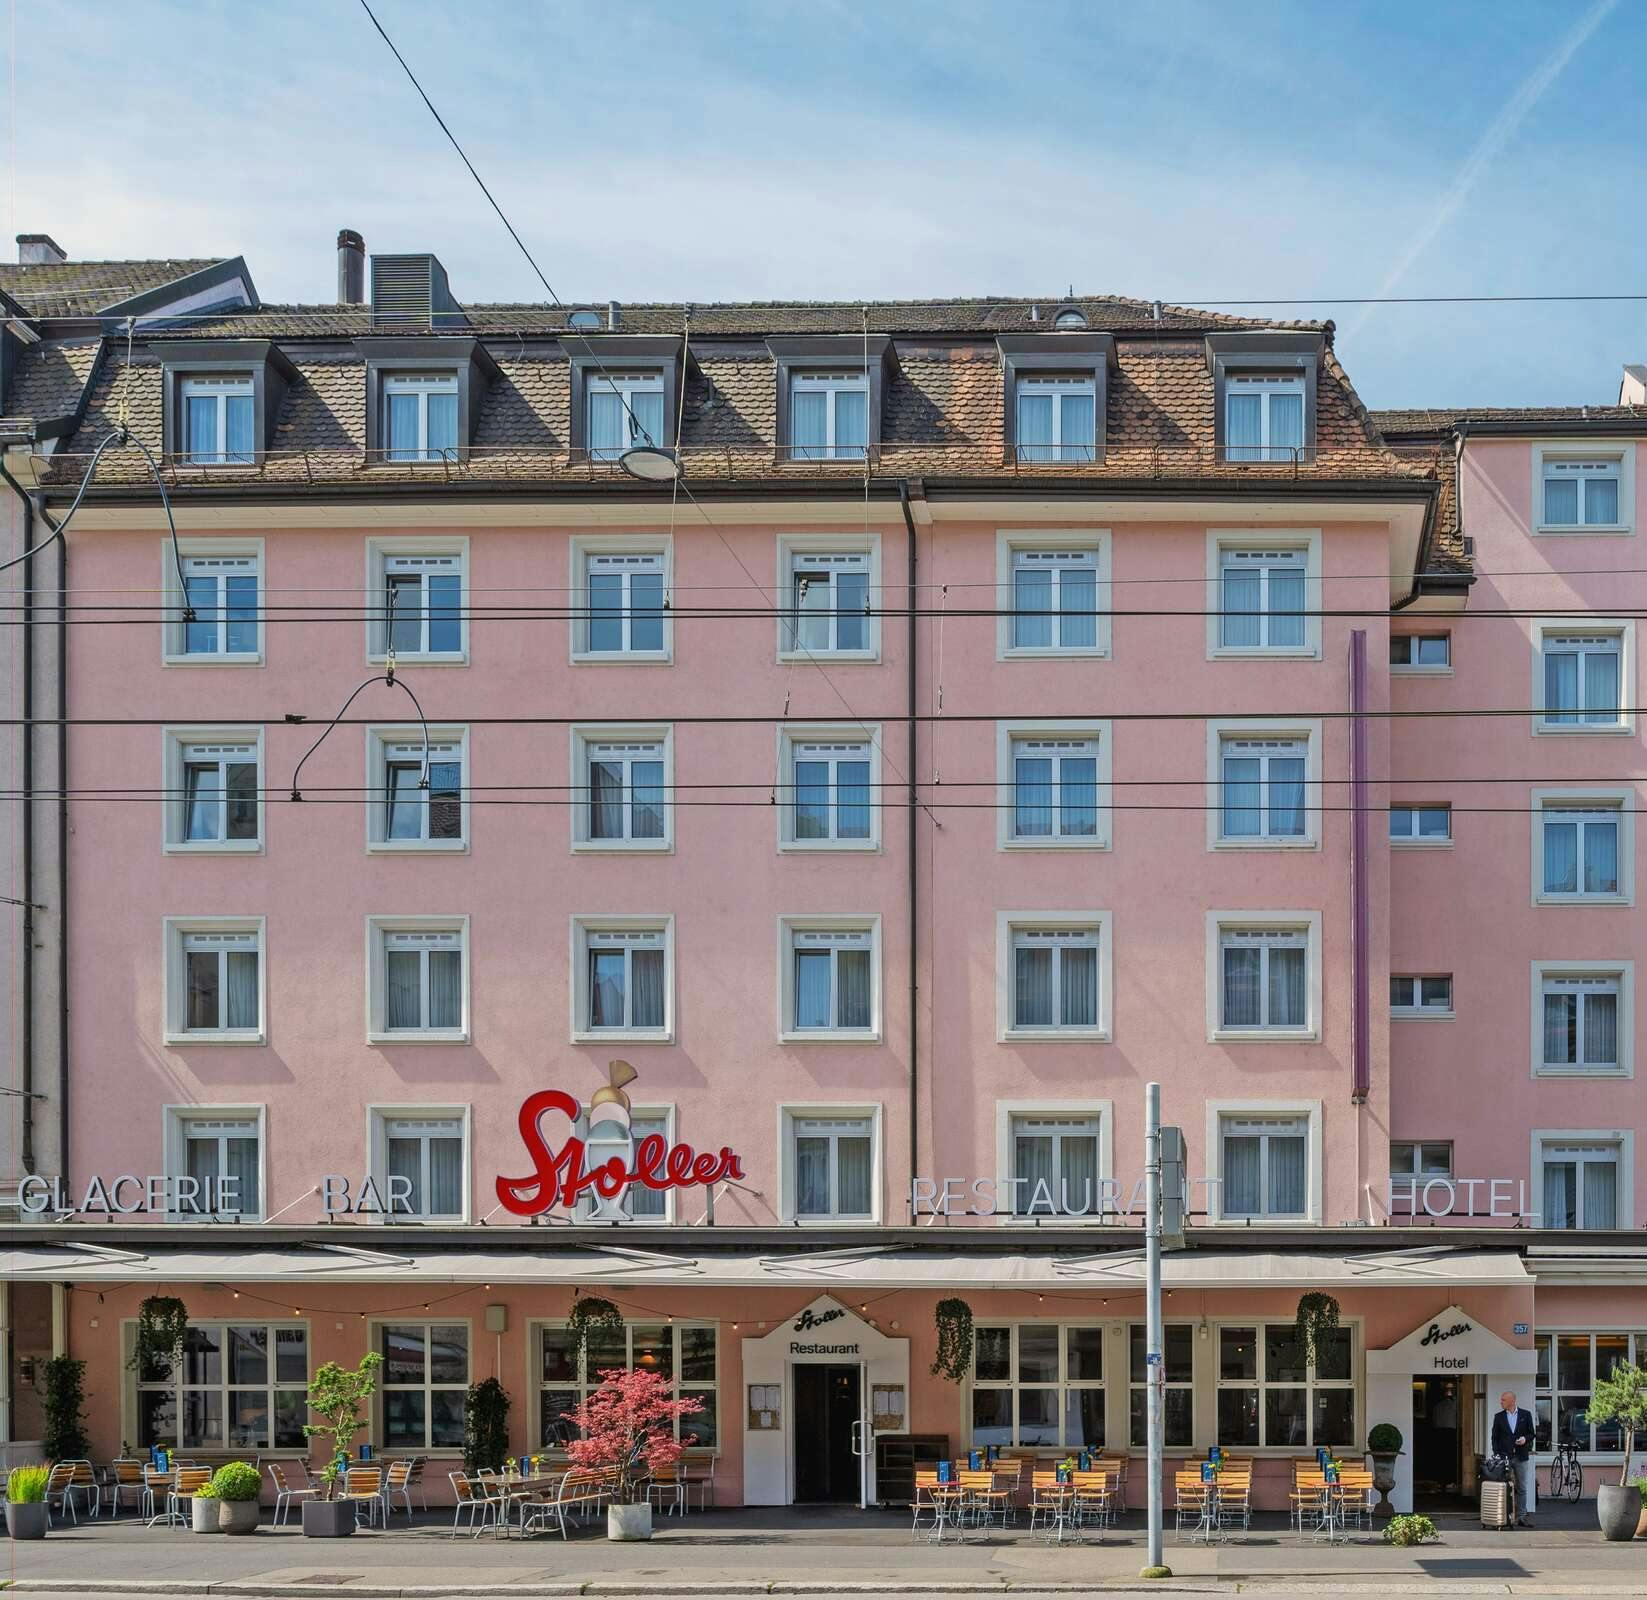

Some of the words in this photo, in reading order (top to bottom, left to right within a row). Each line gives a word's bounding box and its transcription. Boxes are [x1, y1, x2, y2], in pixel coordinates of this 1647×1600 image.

[496, 1089, 745, 1216] Stoller
[17, 1175, 242, 1214] GLACERIE
[322, 1174, 416, 1214] BAR
[1388, 1179, 1541, 1217] HOTEL
[793, 1309, 846, 1332] Stoller
[1420, 1323, 1473, 1346] Stoller
[790, 1342, 860, 1354] Restaurant
[1434, 1356, 1469, 1369] Hotel
